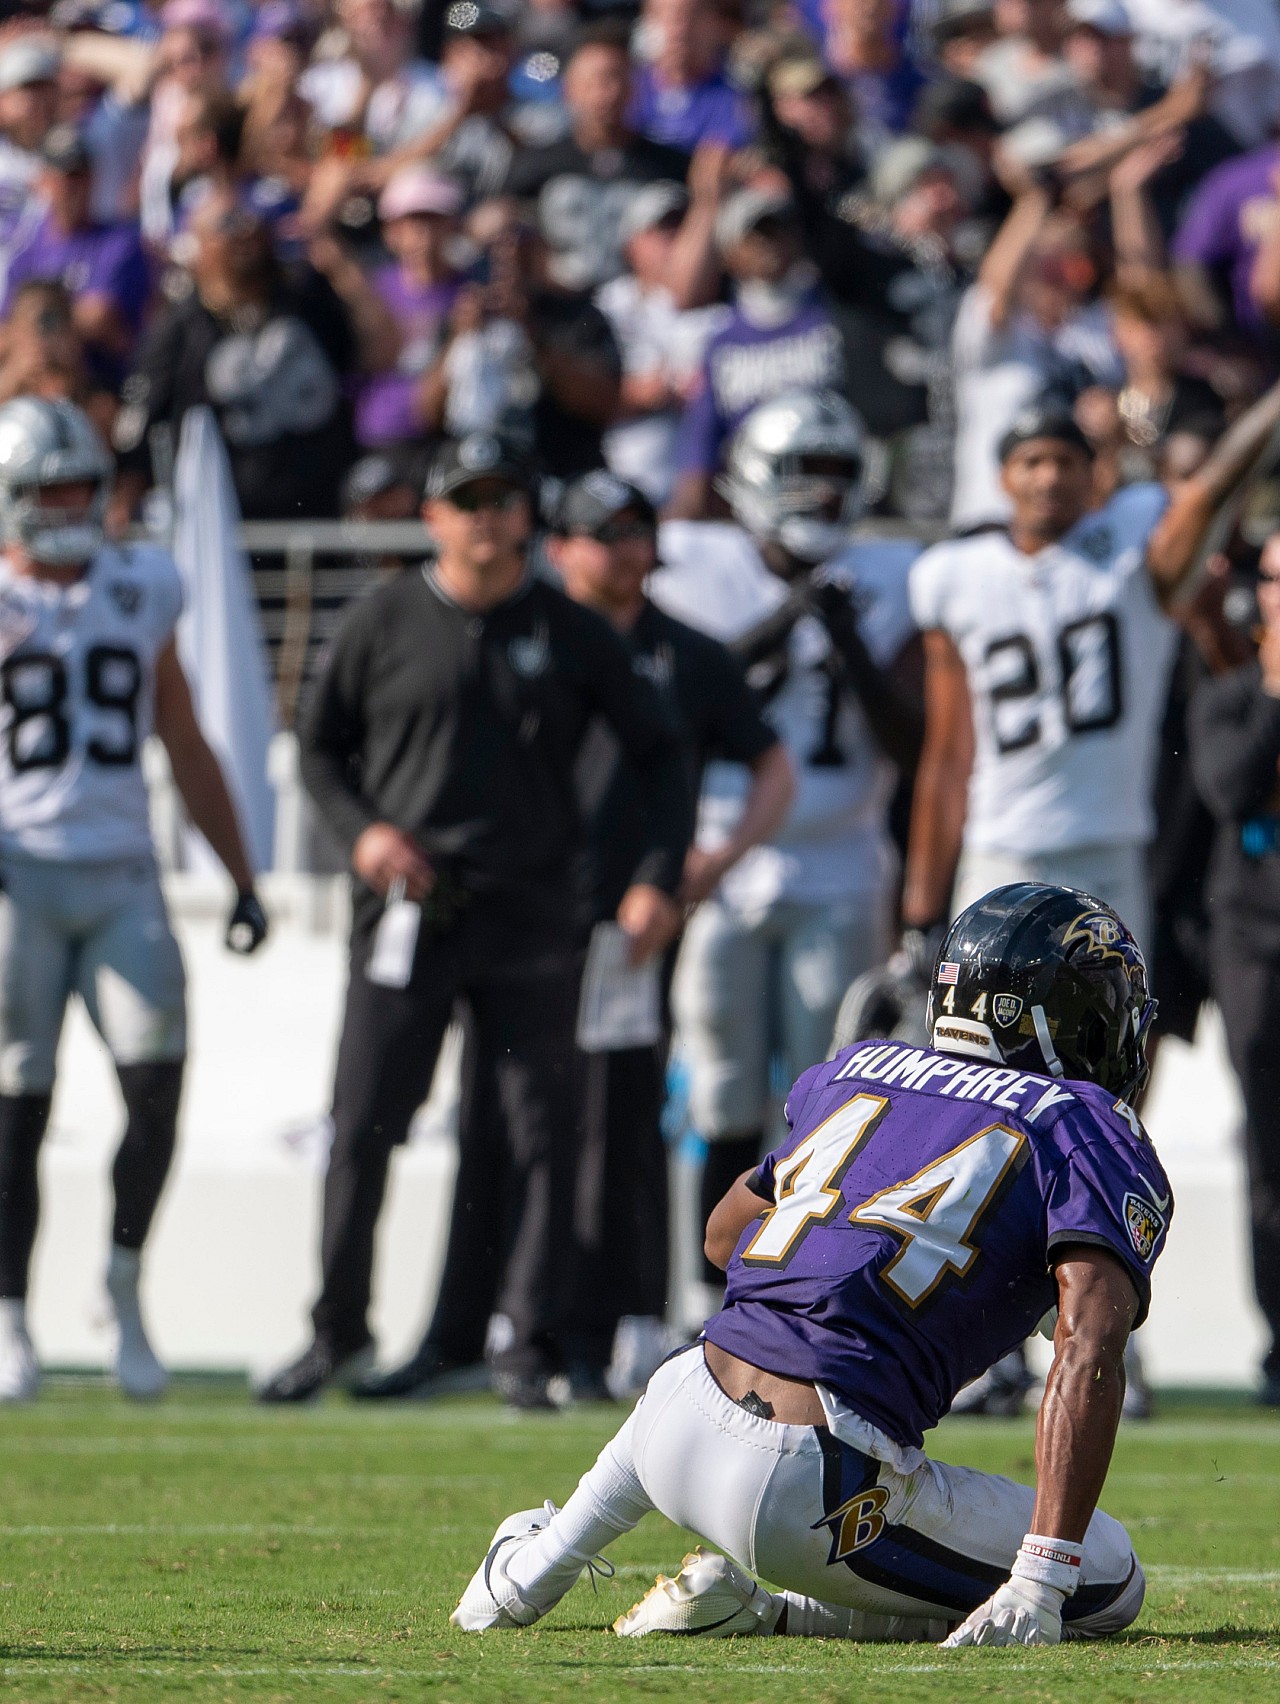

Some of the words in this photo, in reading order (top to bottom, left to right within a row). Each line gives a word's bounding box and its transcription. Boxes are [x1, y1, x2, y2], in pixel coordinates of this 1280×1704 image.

[1, 644, 141, 770] 89
[981, 611, 1123, 755] 20
[935, 1026, 991, 1046] RAVENS
[998, 997, 1011, 1008] JOE
[835, 1046, 1075, 1123] HUMPHREY
[741, 1093, 1029, 1310] 44
[1129, 1197, 1161, 1228] RAVENS
[810, 1485, 891, 1566] B
[1042, 1545, 1072, 1564] FINISH
